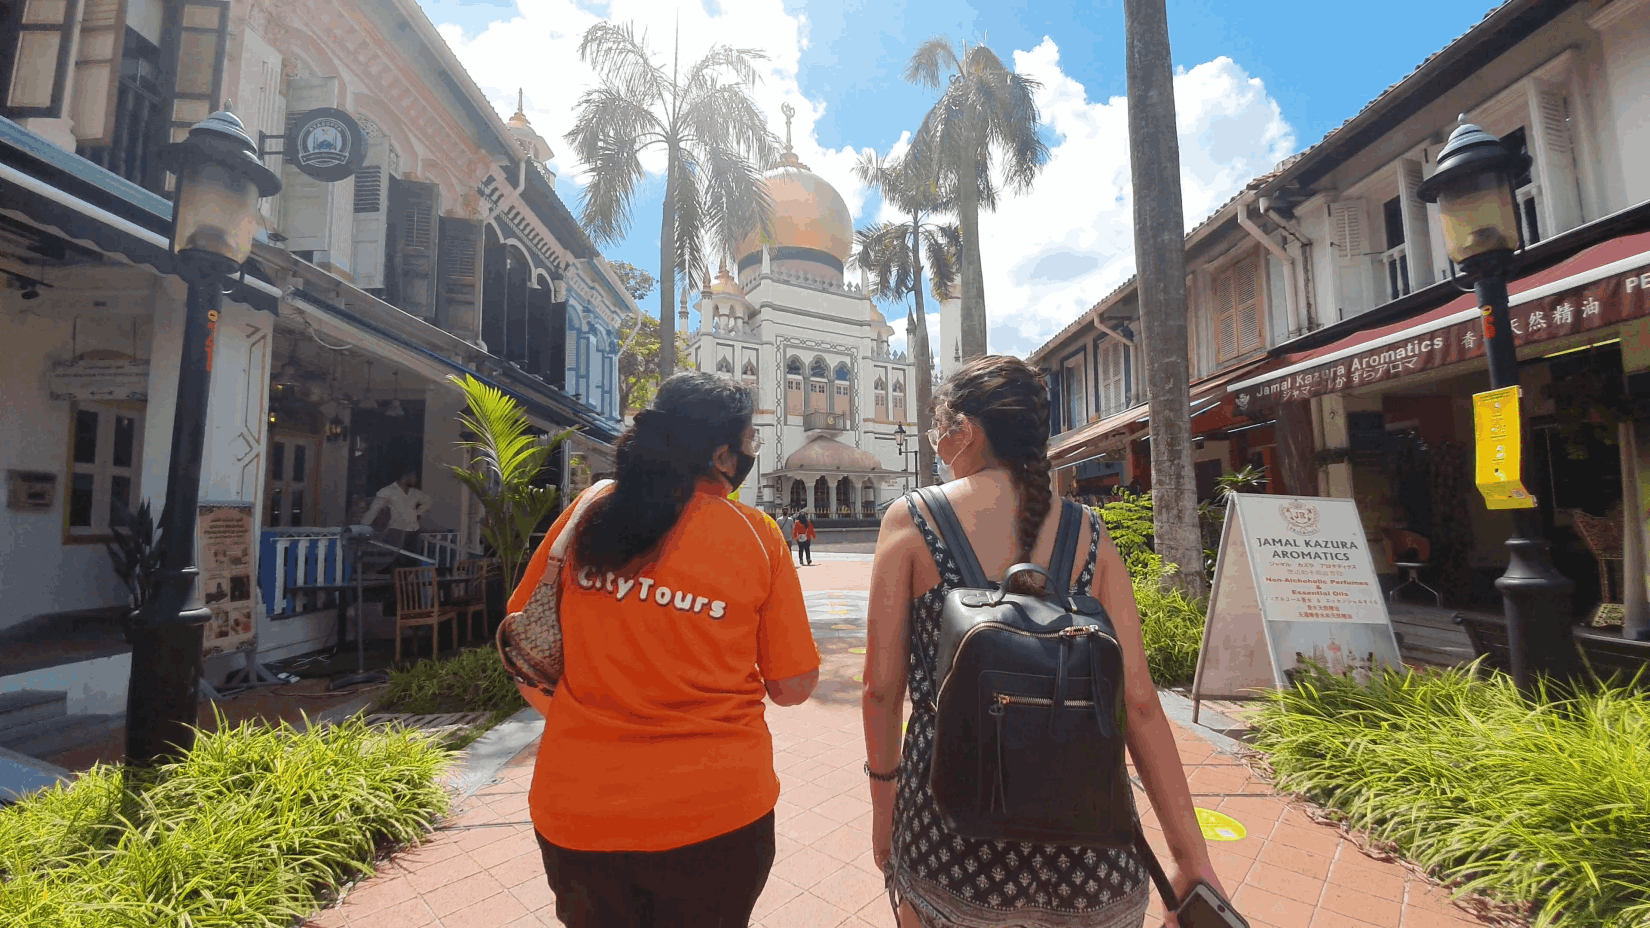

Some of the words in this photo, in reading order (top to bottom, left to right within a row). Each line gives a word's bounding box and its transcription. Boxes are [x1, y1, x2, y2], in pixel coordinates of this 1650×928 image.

[1256, 377, 1292, 398] Jamal
[1295, 365, 1346, 387] Kazura
[1351, 337, 1444, 372] Aromatics
[1256, 538, 1300, 548] JAMAL
[1304, 539, 1359, 550] KAZURA
[1272, 549, 1350, 561] AROMATICS
[577, 565, 727, 619] CityTours
[1291, 589, 1331, 597] Essential
